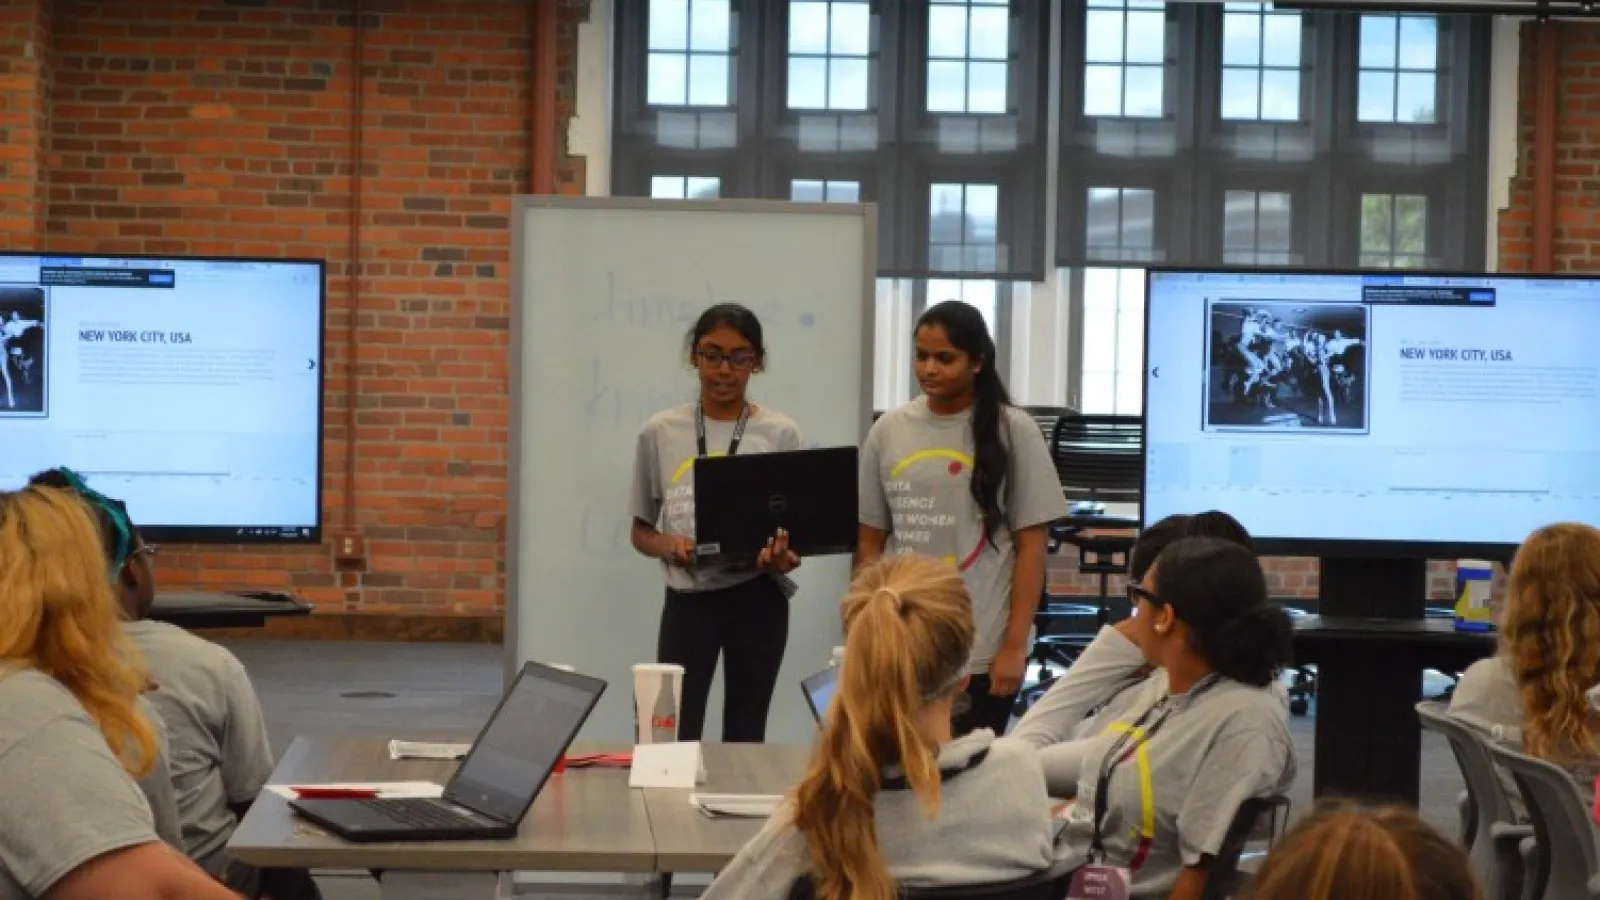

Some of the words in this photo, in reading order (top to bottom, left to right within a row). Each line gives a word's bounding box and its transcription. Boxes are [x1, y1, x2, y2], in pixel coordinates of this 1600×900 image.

[79, 330, 104, 342] NEW
[108, 330, 137, 343] YORK
[141, 330, 166, 344] CITY,
[170, 331, 192, 344] USA
[1400, 347, 1425, 360] NEW
[1429, 348, 1457, 361] YORK
[1461, 349, 1487, 363] CITY,
[1491, 349, 1513, 362] USA
